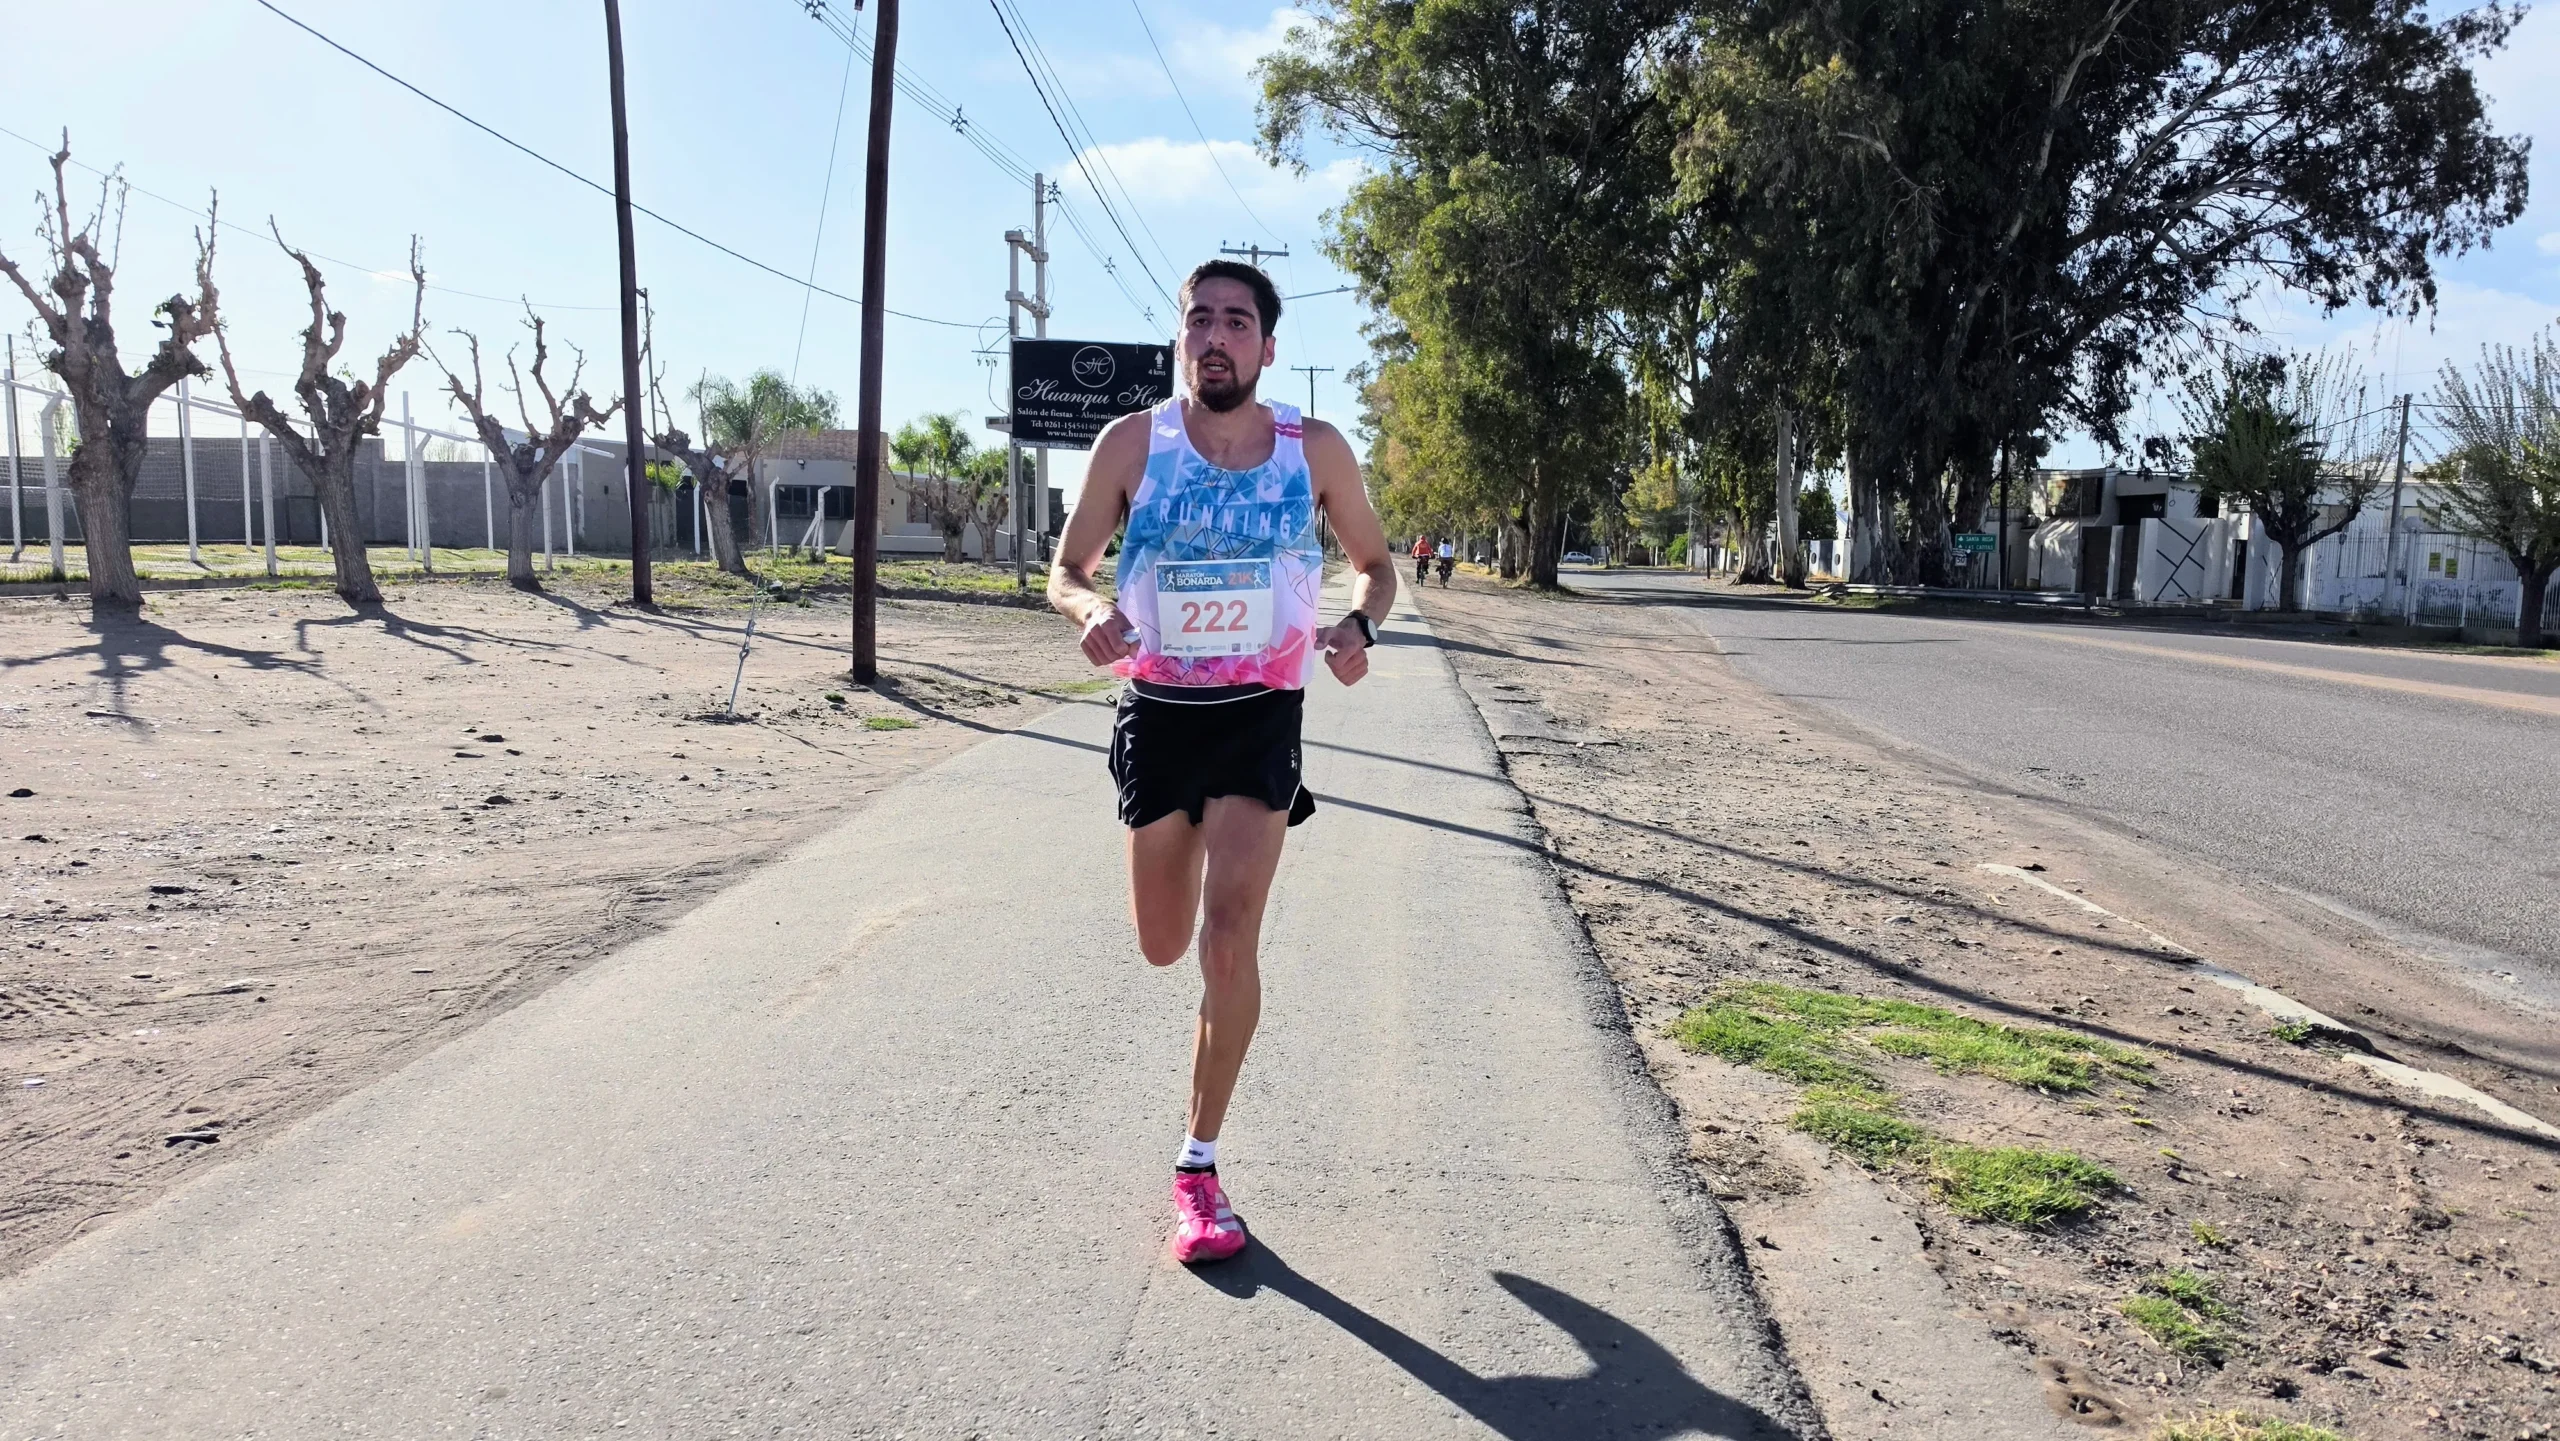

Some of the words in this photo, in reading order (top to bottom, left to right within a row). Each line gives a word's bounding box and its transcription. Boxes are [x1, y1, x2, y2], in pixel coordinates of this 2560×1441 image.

[1017, 407, 1038, 416] Salón
[1039, 408, 1049, 416] de
[1050, 409, 1073, 418] fiestas
[1081, 411, 1122, 420] Alojamient
[1031, 420, 1043, 428] Tel:
[1049, 441, 1081, 449] MUNICIPAL
[1159, 498, 1292, 540] RUNNING
[1176, 576, 1224, 587] BONARDA
[1181, 599, 1249, 633] 222
